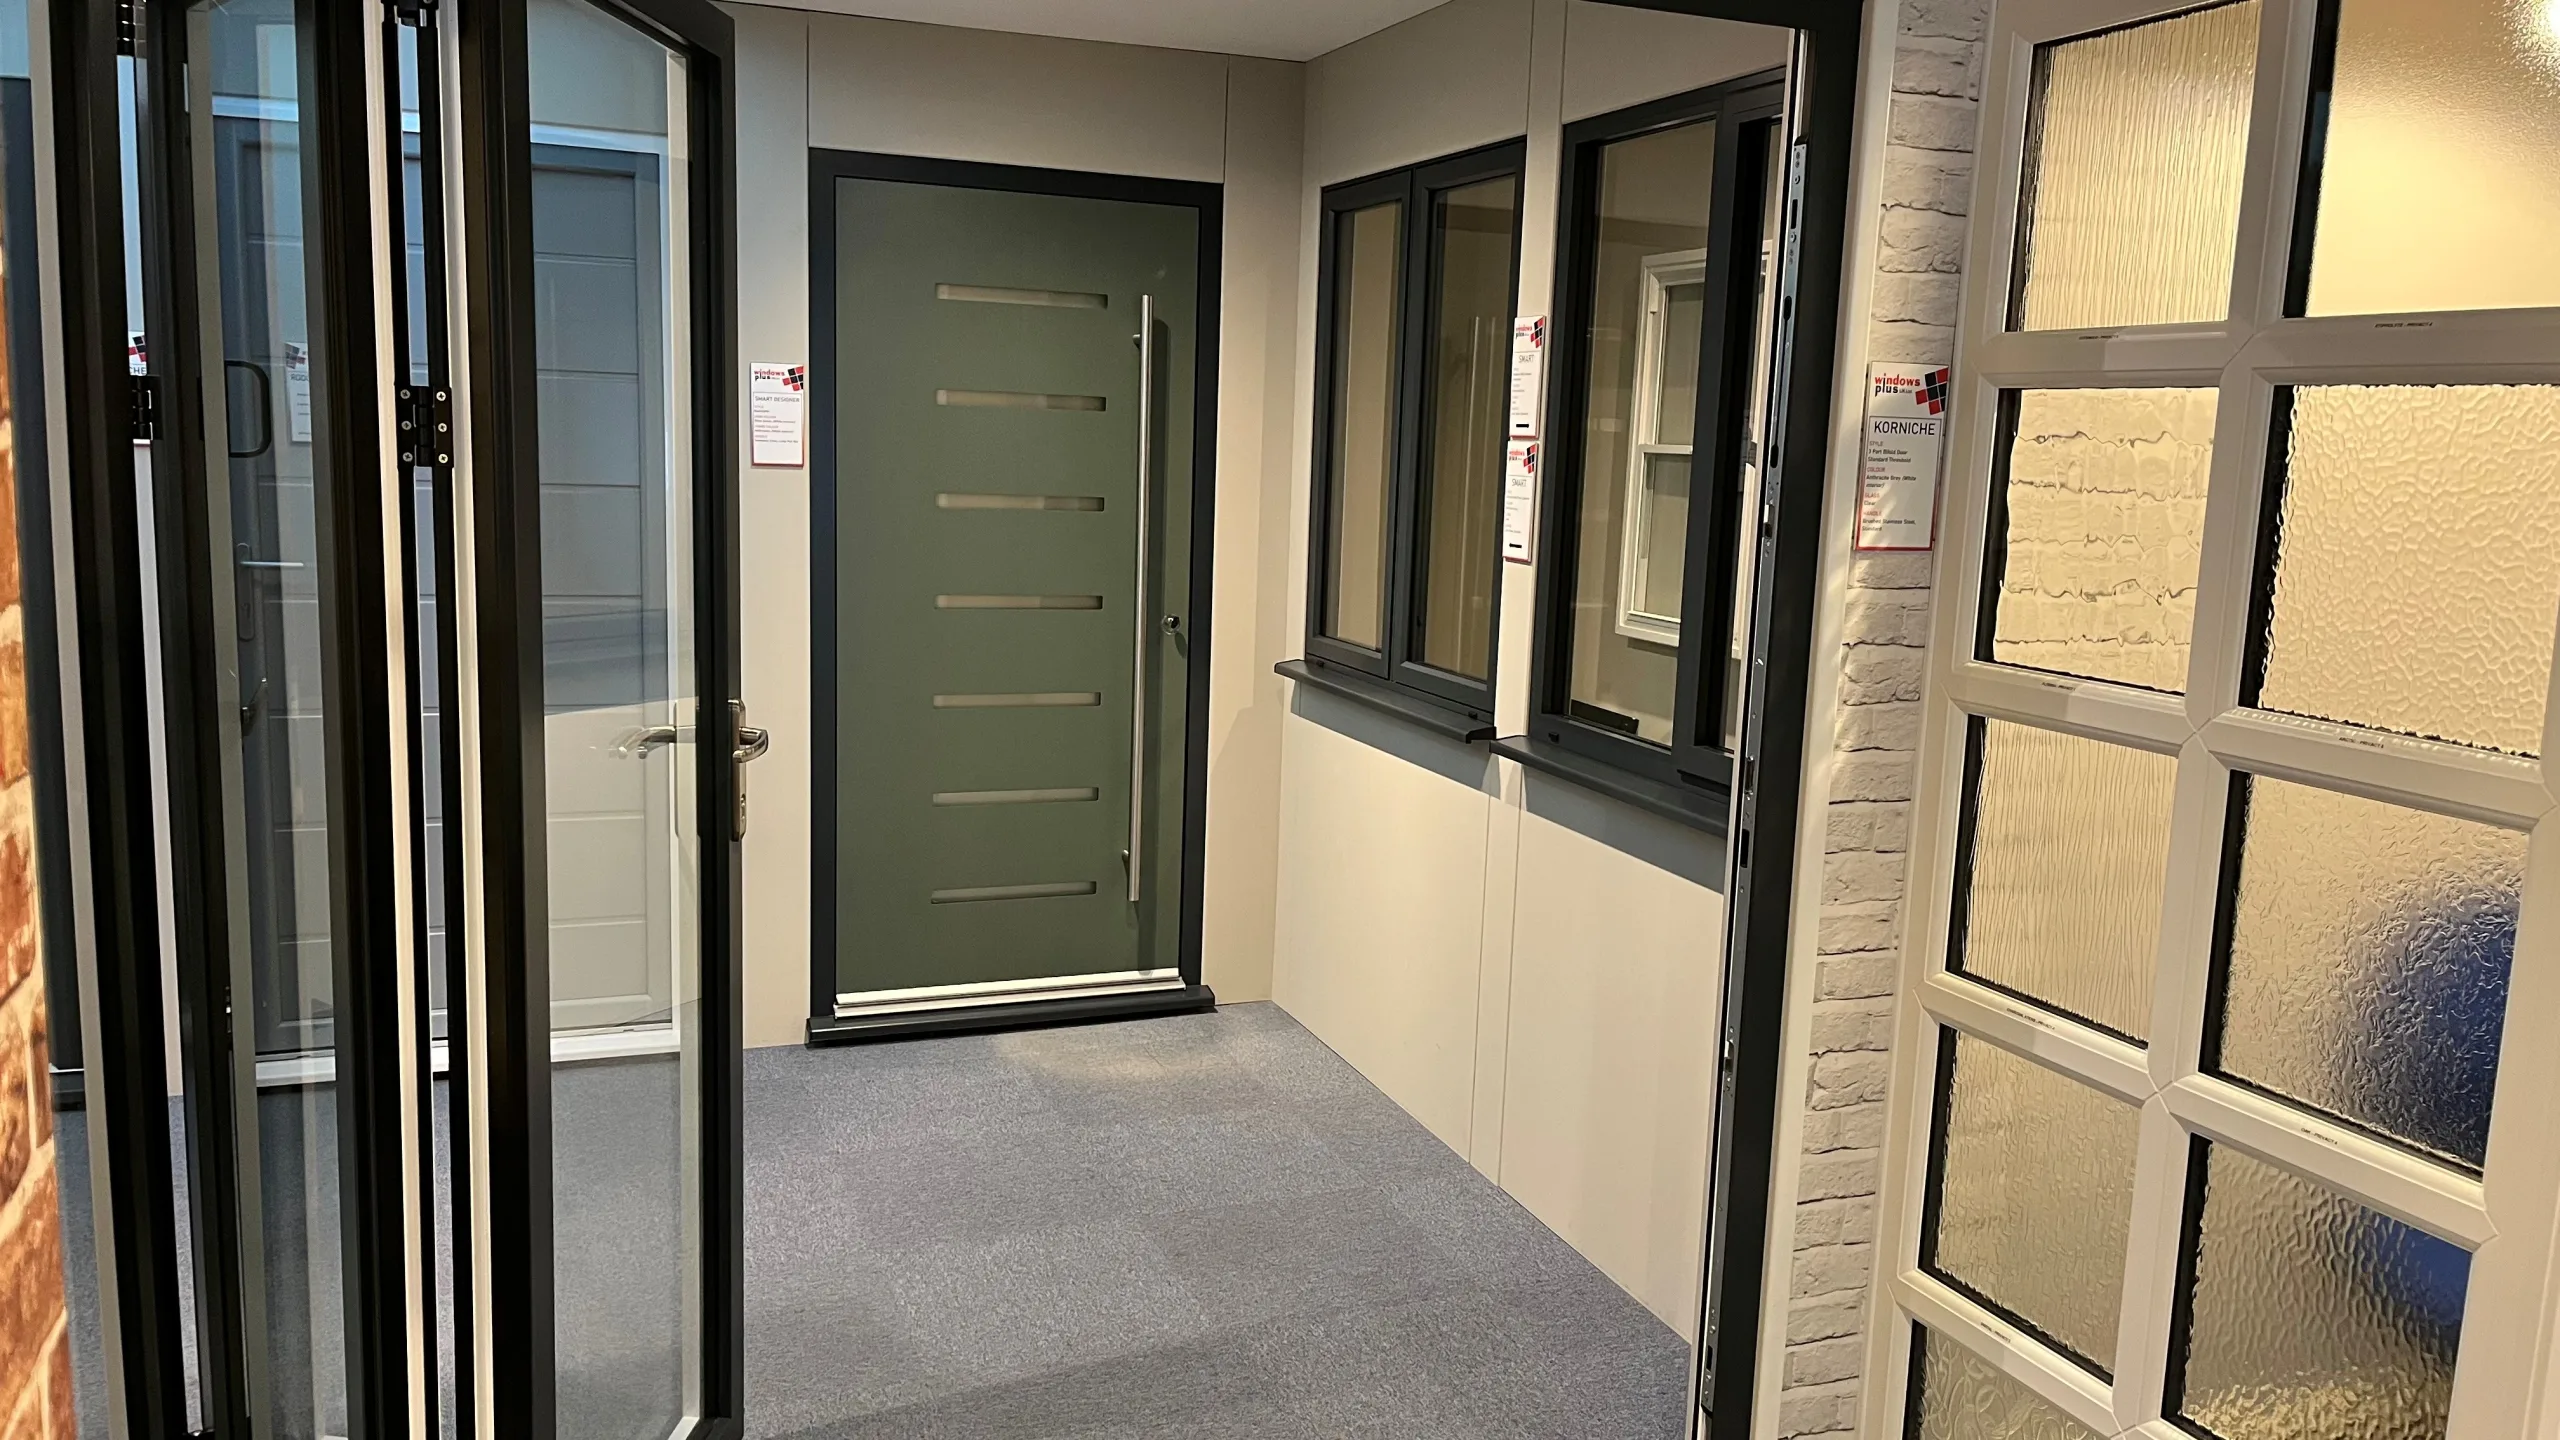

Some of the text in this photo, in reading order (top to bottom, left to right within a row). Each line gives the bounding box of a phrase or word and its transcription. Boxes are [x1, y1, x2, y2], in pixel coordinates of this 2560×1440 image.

[753, 368, 785, 377] windows
[1874, 372, 1921, 387] windows
[1874, 384, 1899, 397] plus
[1873, 420, 1936, 436] KORNICHE
